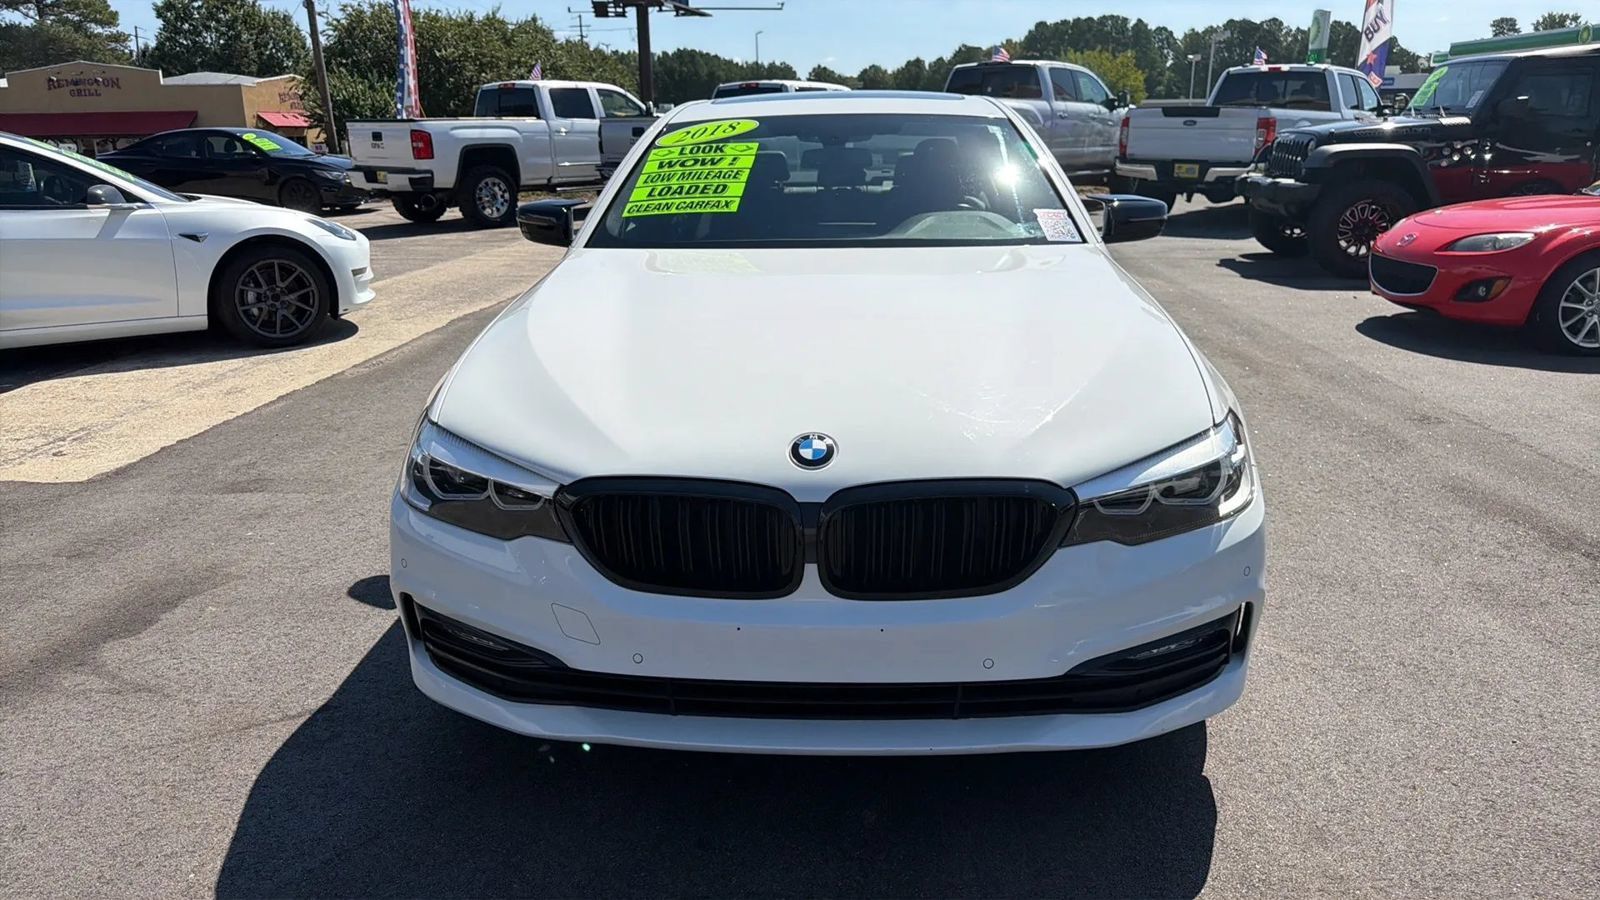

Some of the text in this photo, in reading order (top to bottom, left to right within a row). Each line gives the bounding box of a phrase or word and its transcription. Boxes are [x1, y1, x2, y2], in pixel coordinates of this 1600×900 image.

[1364, 10, 1388, 42] BUY
[69, 89, 101, 97] GRILL
[672, 121, 741, 142] 2018
[678, 144, 726, 156] LOOK
[643, 169, 744, 185] LOW MILEAGE
[646, 183, 729, 198] LOADED
[626, 199, 733, 214] CLEAN CARFAX
